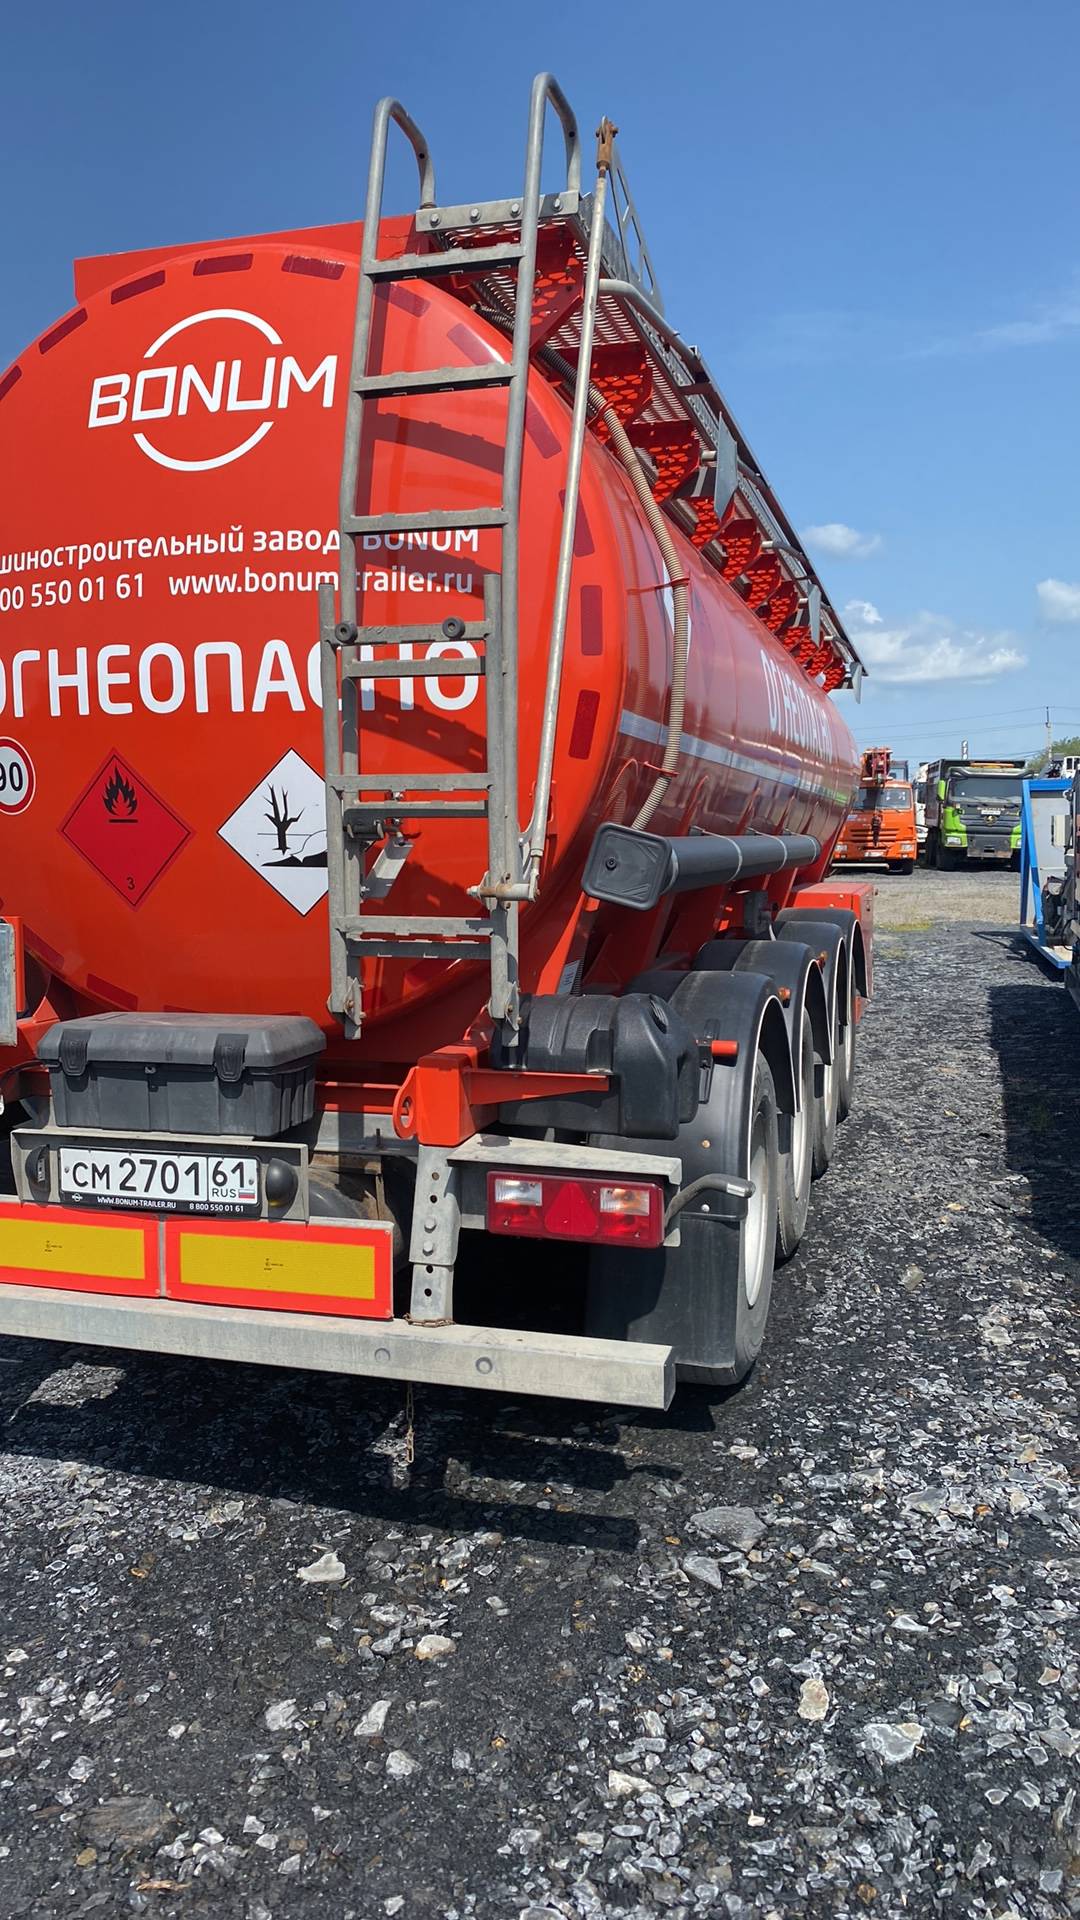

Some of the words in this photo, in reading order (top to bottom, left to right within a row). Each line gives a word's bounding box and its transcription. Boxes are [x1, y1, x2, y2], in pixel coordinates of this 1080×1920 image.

[87, 354, 339, 429] BONUM
[252, 529, 341, 554] завод
[362, 527, 479, 552] BONUM
[31, 577, 72, 608] 550
[78, 575, 105, 602] 01
[116, 572, 144, 599] 61
[126, 876, 136, 891] 3
[211, 1187, 237, 1198] RUS
[96, 1196, 177, 1209] WWW.BONUM-TRAILER.RU
[196, 1203, 208, 1211] 800
[210, 1204, 223, 1212] 550
